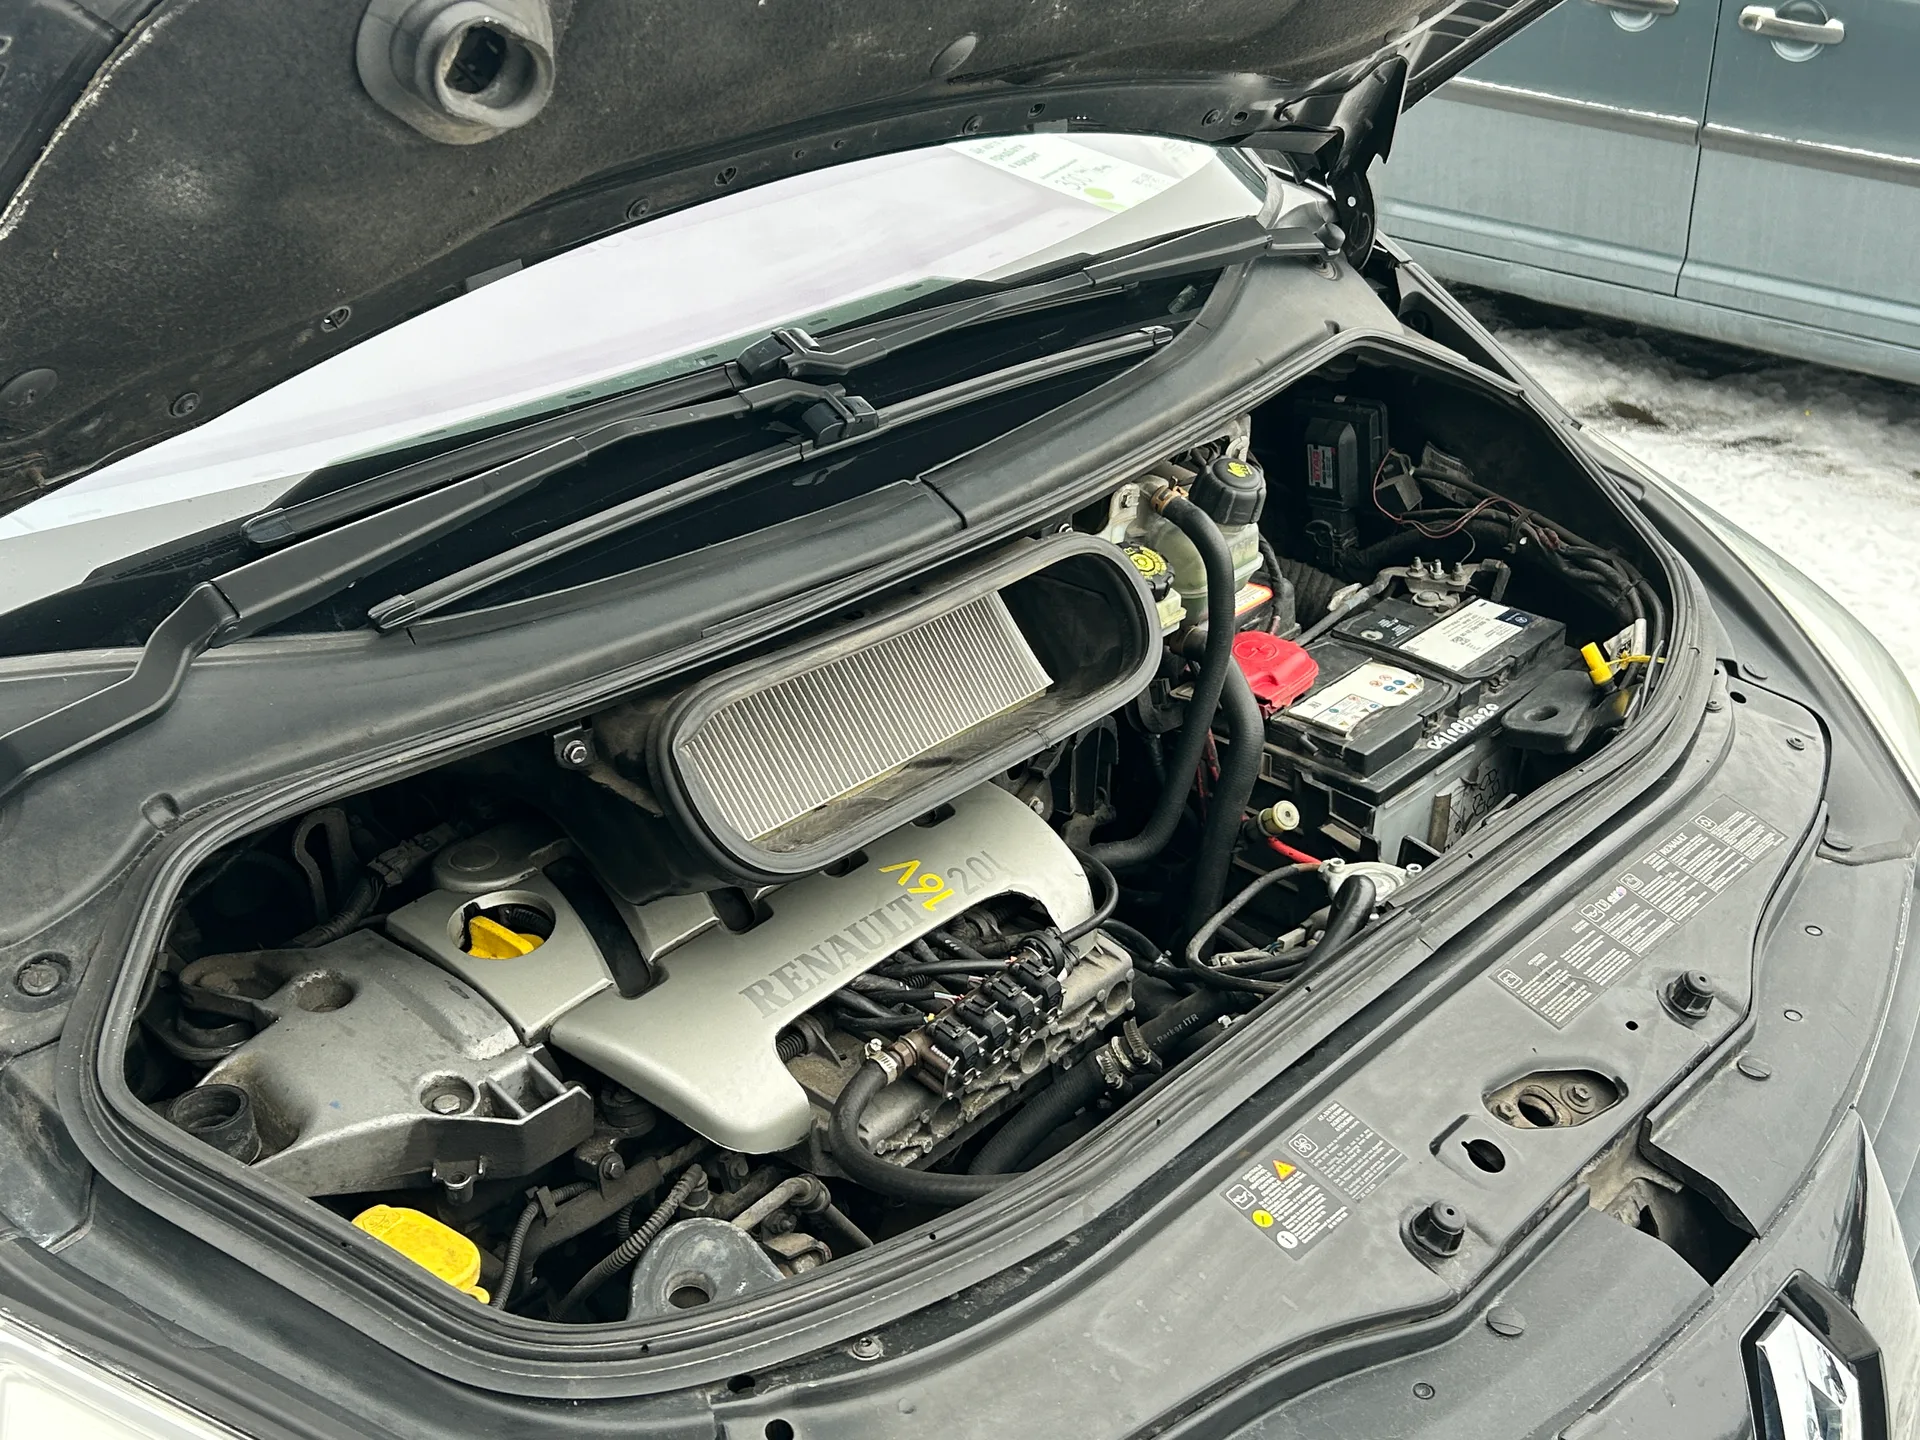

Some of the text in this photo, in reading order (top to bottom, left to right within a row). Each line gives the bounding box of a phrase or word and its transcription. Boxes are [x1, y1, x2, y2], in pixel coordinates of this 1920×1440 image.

[1659, 832, 1688, 856] RENAULT
[738, 894, 925, 1019] RENAULT
[1182, 1013, 1199, 1027] ITR
